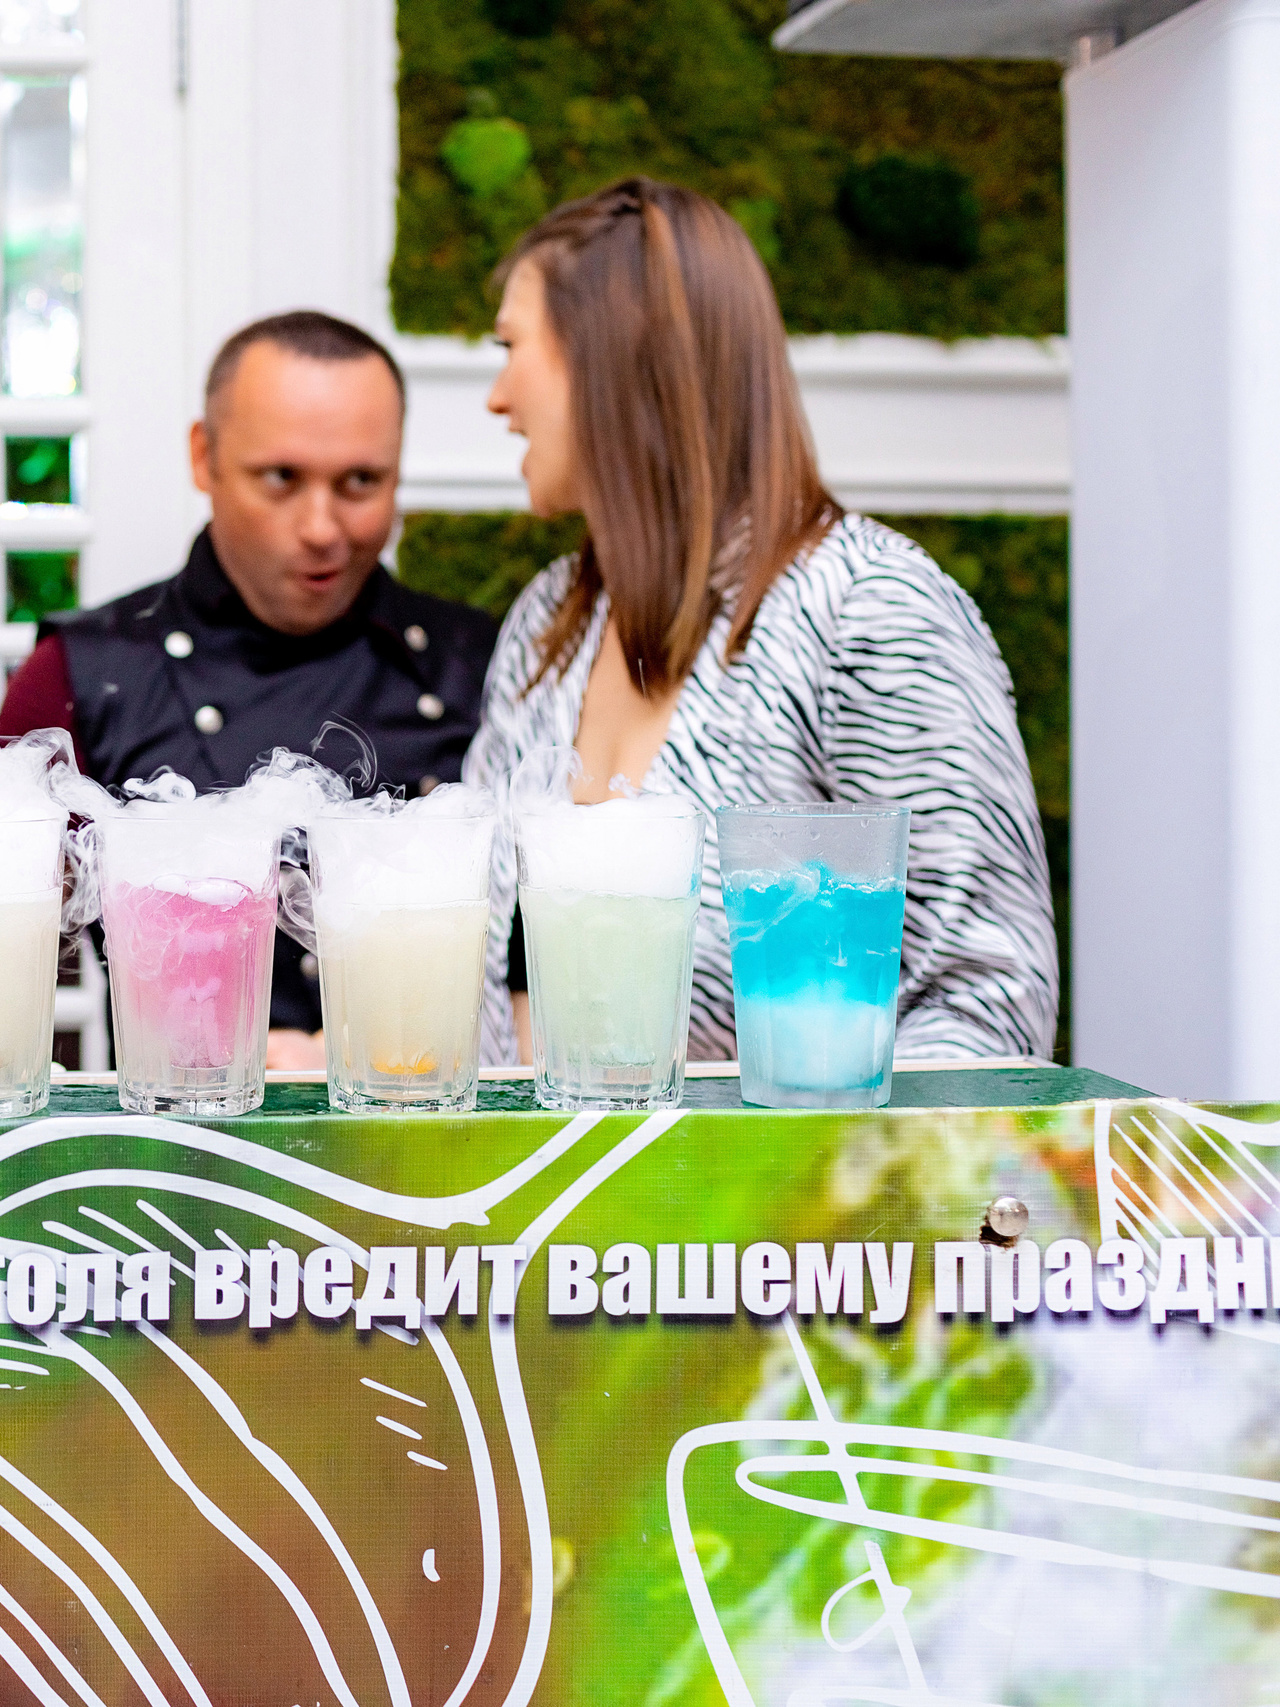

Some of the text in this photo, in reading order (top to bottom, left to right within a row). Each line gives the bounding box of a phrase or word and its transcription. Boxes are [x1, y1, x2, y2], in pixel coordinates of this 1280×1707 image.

[194, 1244, 528, 1330] вредит
[548, 1241, 914, 1324] вашему
[934, 1237, 1280, 1324] праздн
